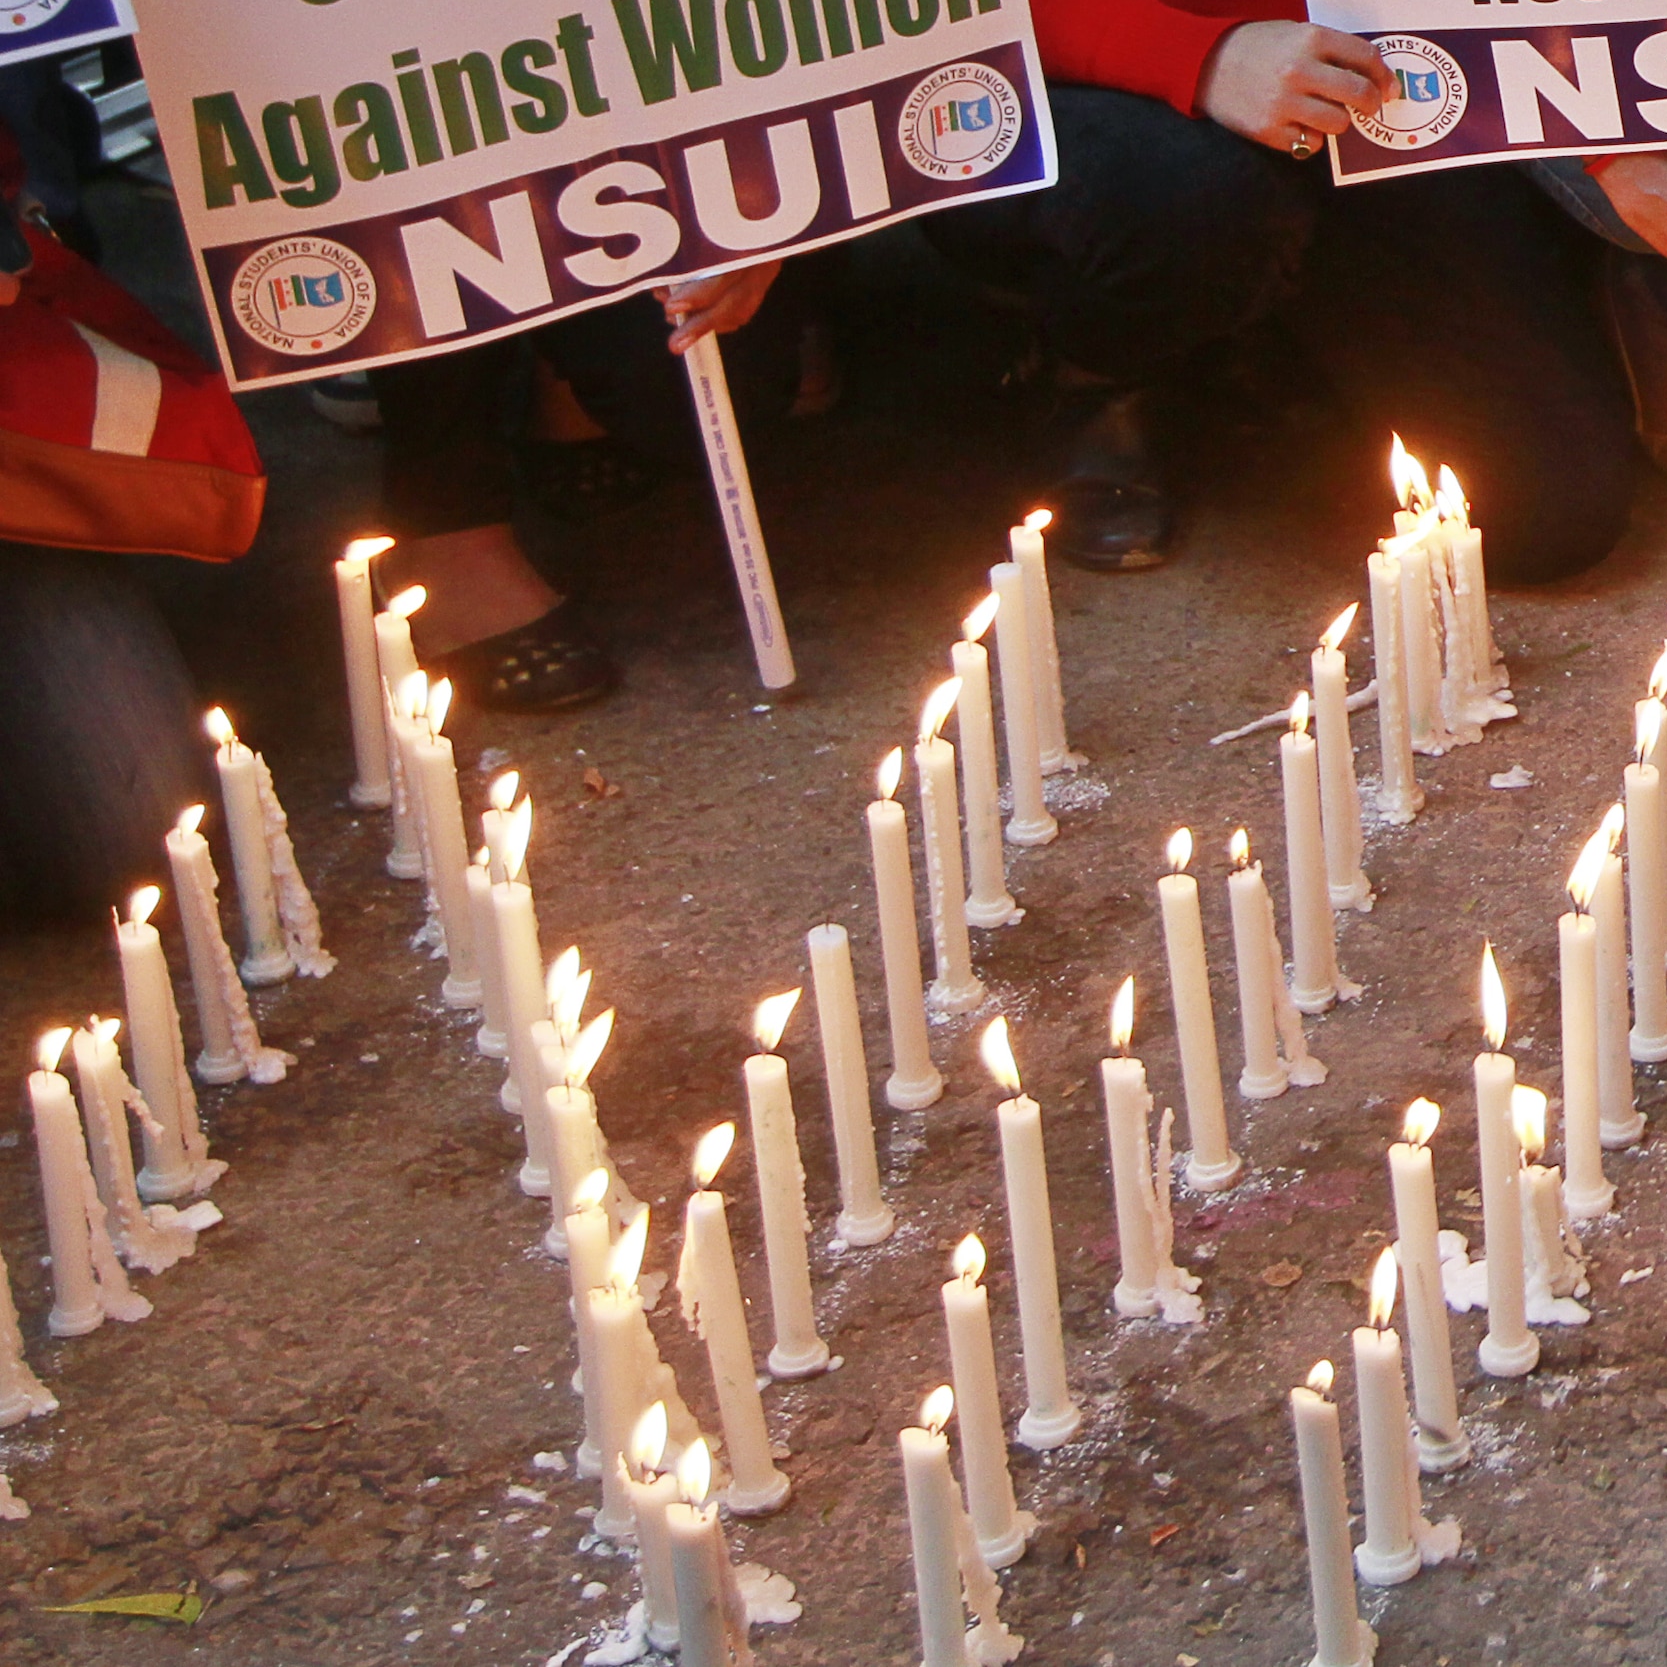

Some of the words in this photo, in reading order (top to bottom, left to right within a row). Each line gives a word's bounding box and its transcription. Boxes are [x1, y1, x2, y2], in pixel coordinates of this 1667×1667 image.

[190, 14, 610, 211] Against
[400, 100, 893, 338] NSUI
[236, 240, 317, 288] STUDENTS'
[319, 242, 367, 279] UNION
[354, 281, 372, 300] OF
[235, 294, 294, 350] NATIONAL
[332, 304, 370, 341] INDIA
